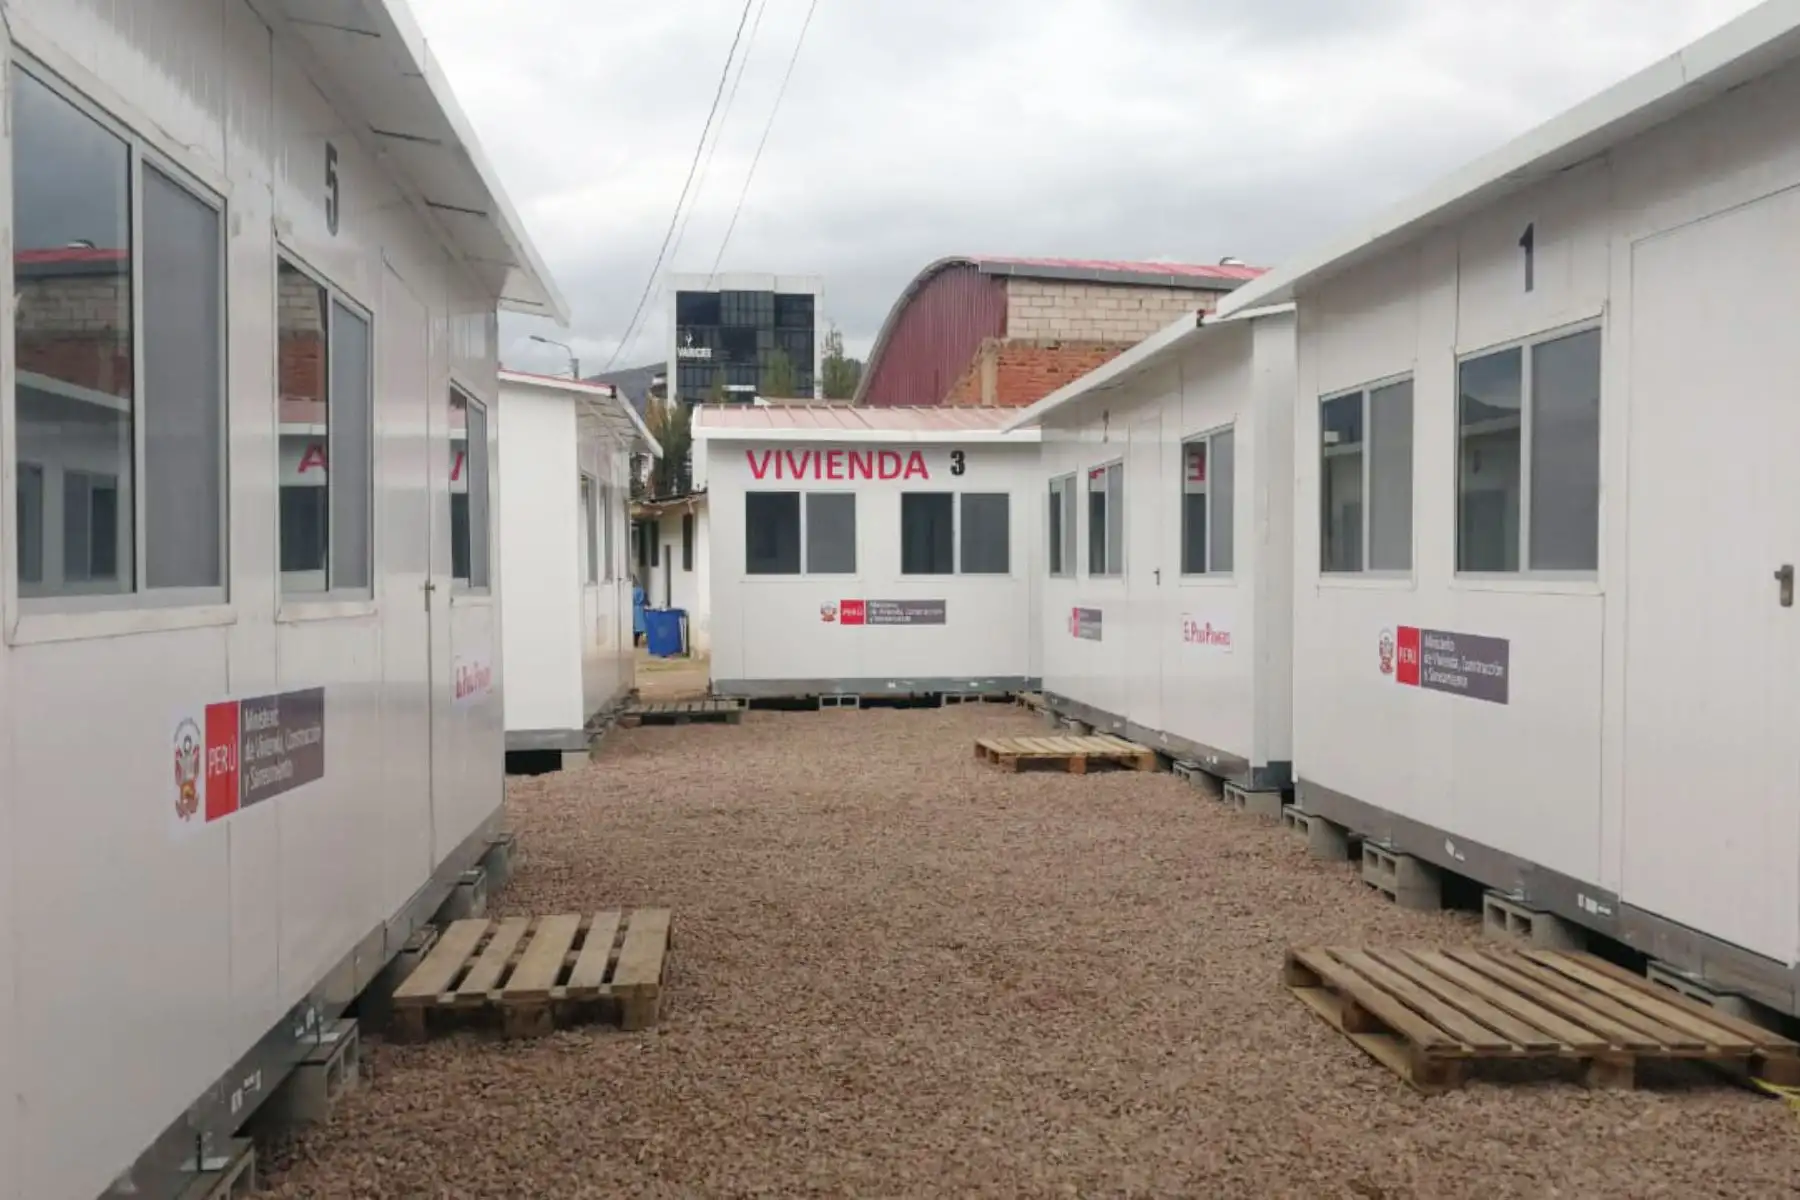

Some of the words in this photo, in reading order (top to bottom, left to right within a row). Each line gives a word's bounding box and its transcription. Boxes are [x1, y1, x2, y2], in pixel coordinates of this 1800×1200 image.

[325, 140, 339, 237] 5
[1518, 222, 1534, 293] 1
[745, 449, 929, 480] VIVIENDA
[949, 450, 967, 476] 3
